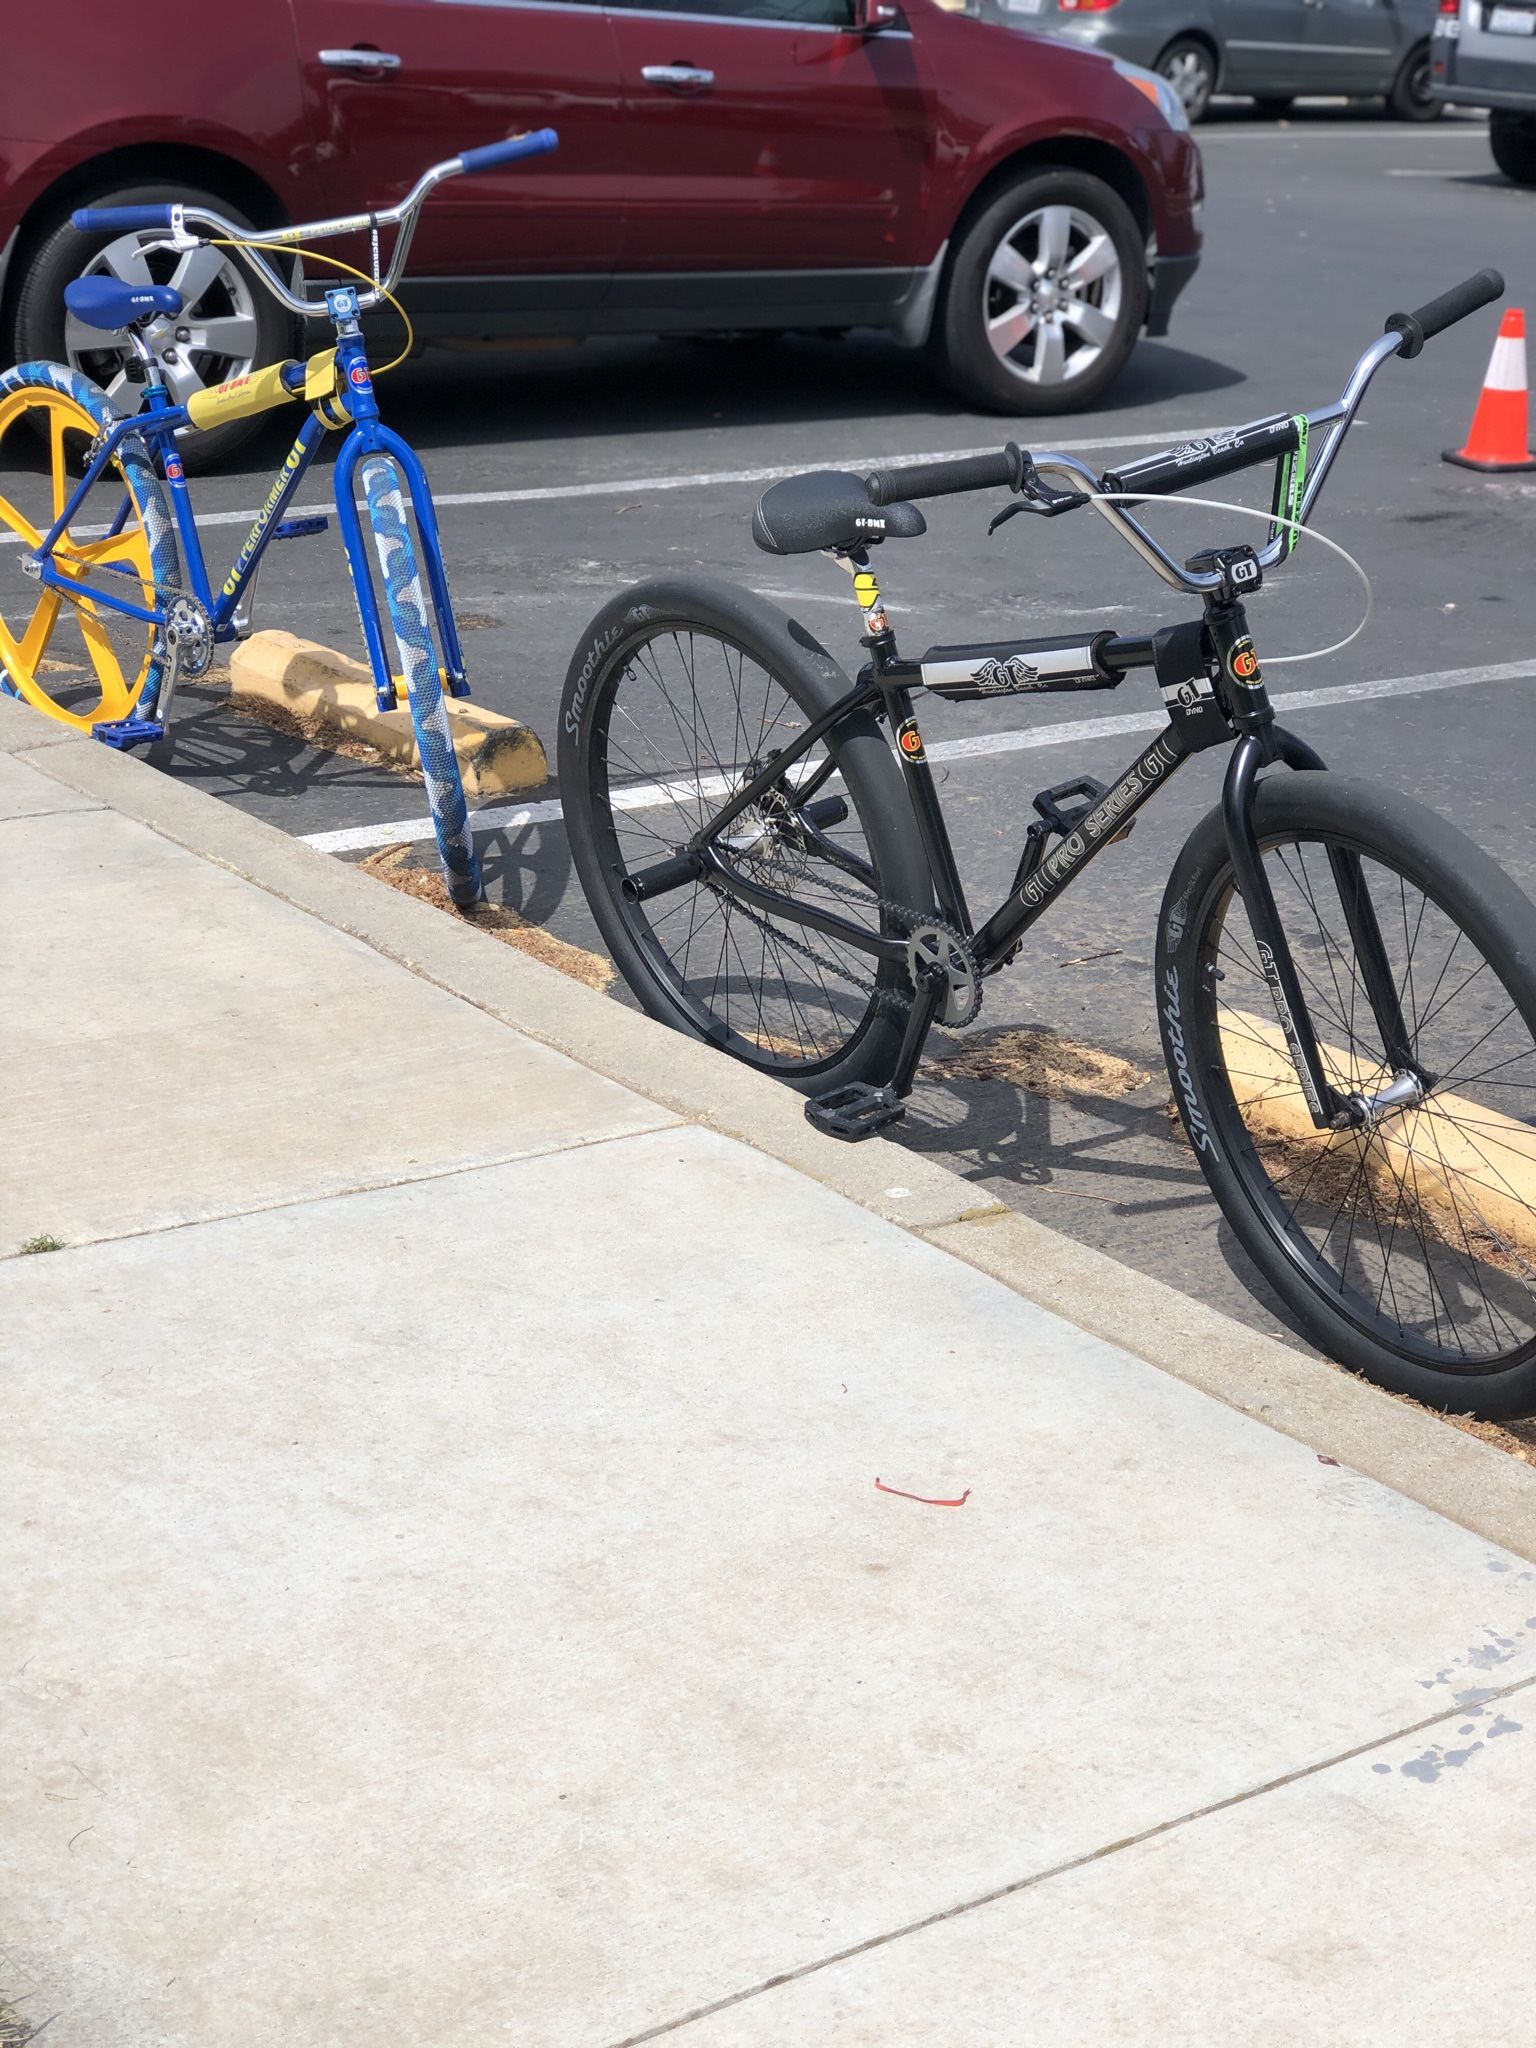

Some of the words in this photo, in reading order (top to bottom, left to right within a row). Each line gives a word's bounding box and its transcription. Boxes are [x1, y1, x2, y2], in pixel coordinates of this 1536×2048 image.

[371, 229, 381, 300] #SJCRUIZS
[336, 299, 349, 308] GT
[1269, 421, 1290, 434] DYNO
[1176, 452, 1211, 466] Huntington
[240, 468, 291, 561] PERFORMER
[855, 518, 886, 529] GT-BMX
[1235, 563, 1252, 580] GT
[565, 626, 624, 746] Smoothie
[992, 663, 1020, 686] GT
[1177, 679, 1201, 707] GT
[1185, 706, 1204, 716] DYNO
[1046, 832, 1086, 879] PRO
[1085, 769, 1144, 838] SERIES
[1163, 965, 1220, 1163] Smoothie
